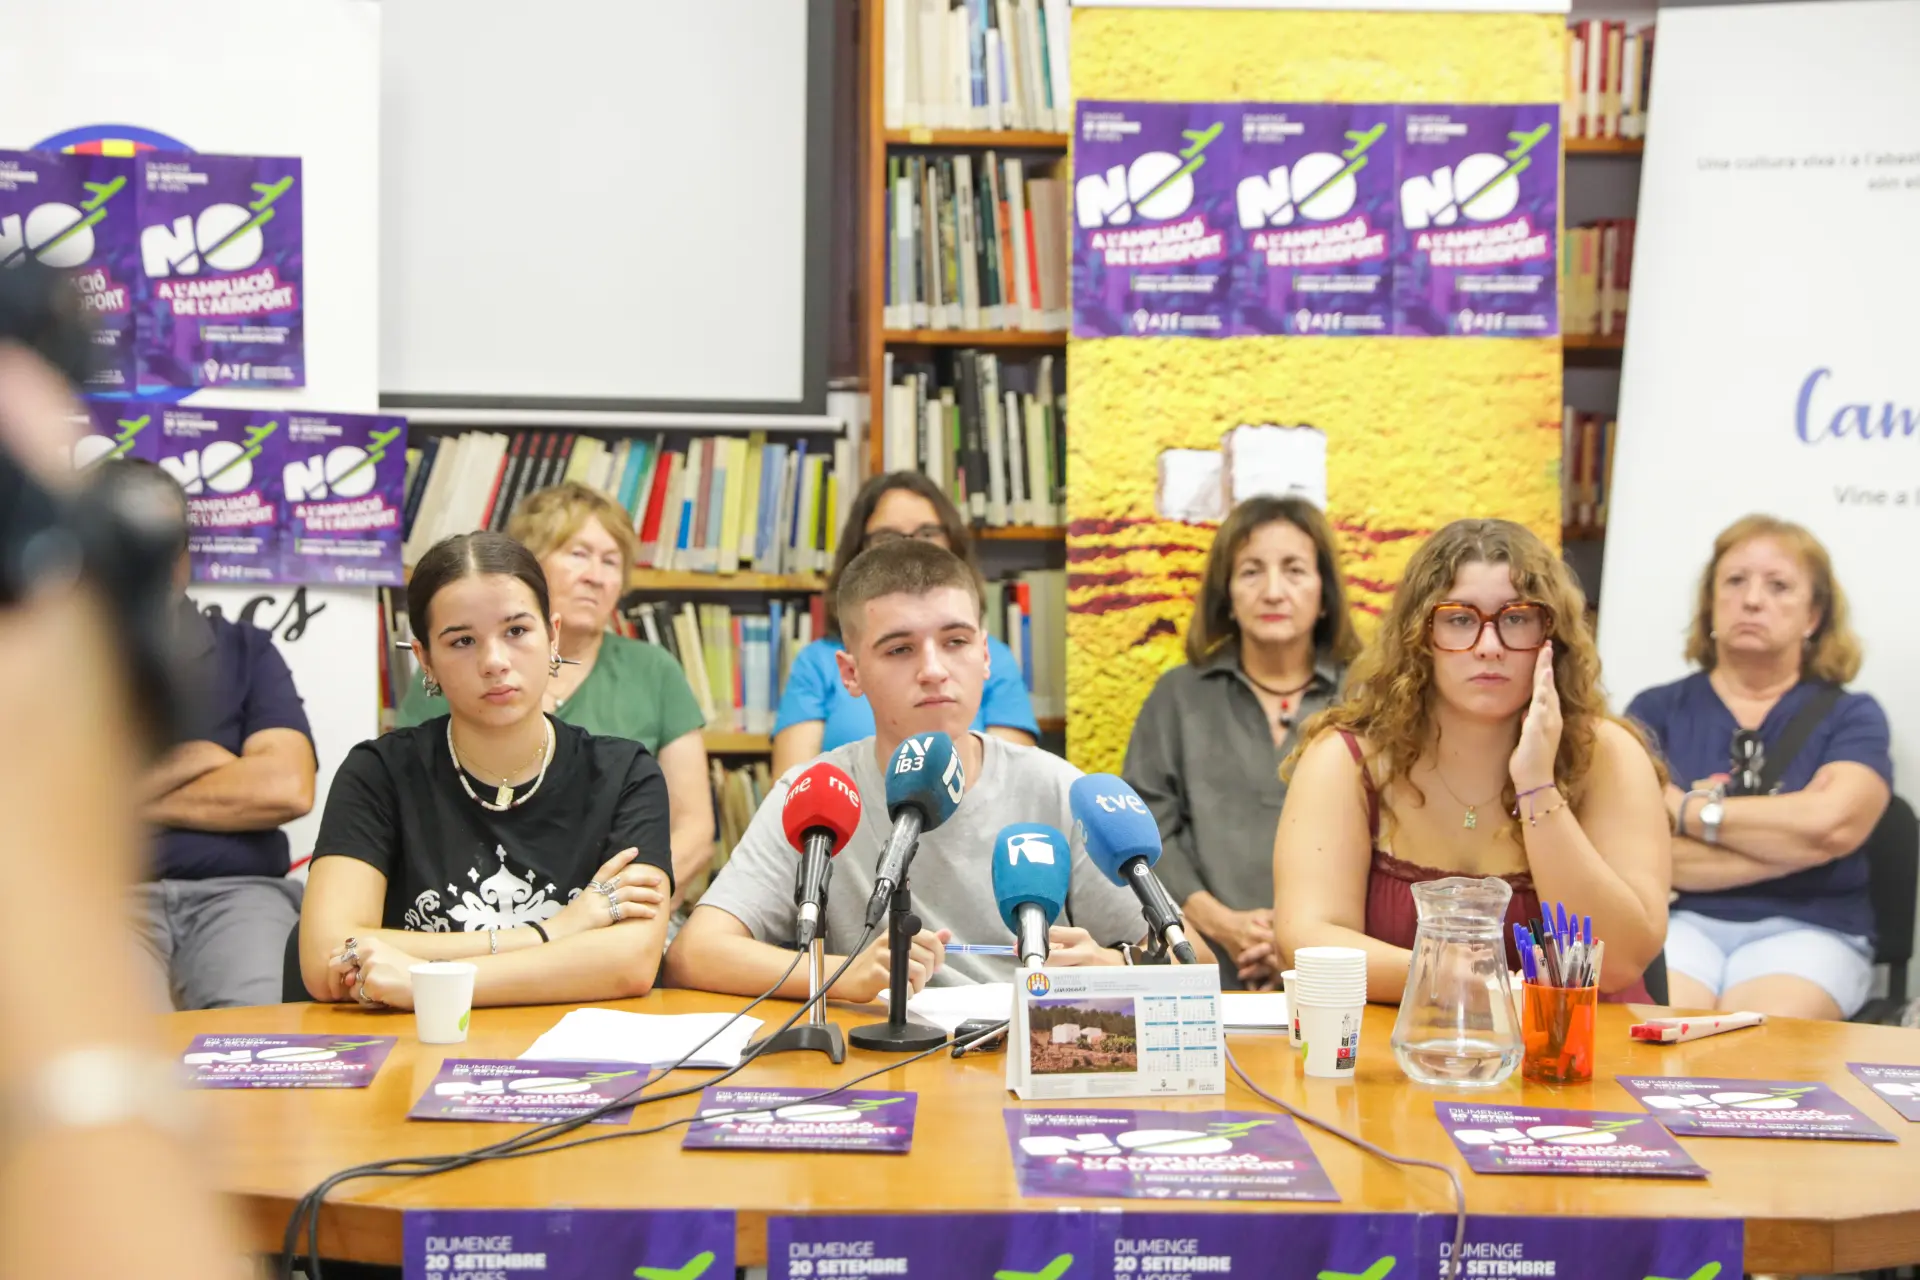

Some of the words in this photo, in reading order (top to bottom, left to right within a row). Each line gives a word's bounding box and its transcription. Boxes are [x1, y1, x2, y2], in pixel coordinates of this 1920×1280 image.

[1076, 151, 1194, 229] NO
[1236, 152, 1357, 229] NO
[1400, 152, 1519, 230] NO
[140, 203, 263, 278] NO
[1091, 233, 1105, 249] A
[1253, 233, 1268, 250] A
[1417, 233, 1431, 250] A
[158, 282, 173, 298] A
[174, 268, 275, 299] L'AMPLIACIÓ
[172, 299, 197, 315] DE
[283, 445, 377, 502] NO
[1833, 485, 1888, 506] Vine
[1894, 491, 1908, 506] a
[784, 777, 812, 806] rne
[828, 776, 860, 808] rne
[1095, 794, 1147, 815] tve
[184, 1046, 337, 1064] NO
[434, 1077, 592, 1095] NO
[1641, 1092, 1798, 1109] NO
[1449, 1107, 1513, 1115] DIUMENGE
[1019, 1129, 1233, 1156] NO
[1453, 1125, 1617, 1145] NO
[425, 1236, 512, 1252] DIUMENGE
[789, 1241, 875, 1258] DIUMENGE
[1114, 1239, 1198, 1255] DIUMENGE
[425, 1253, 450, 1271] 20
[454, 1252, 547, 1270] SETEMBRE
[788, 1259, 814, 1276] 20
[817, 1257, 908, 1276] SETEMBRE
[1113, 1256, 1138, 1272] 20
[1141, 1256, 1232, 1272] SETEMBRE
[1466, 1260, 1556, 1276] SETEMBRE
